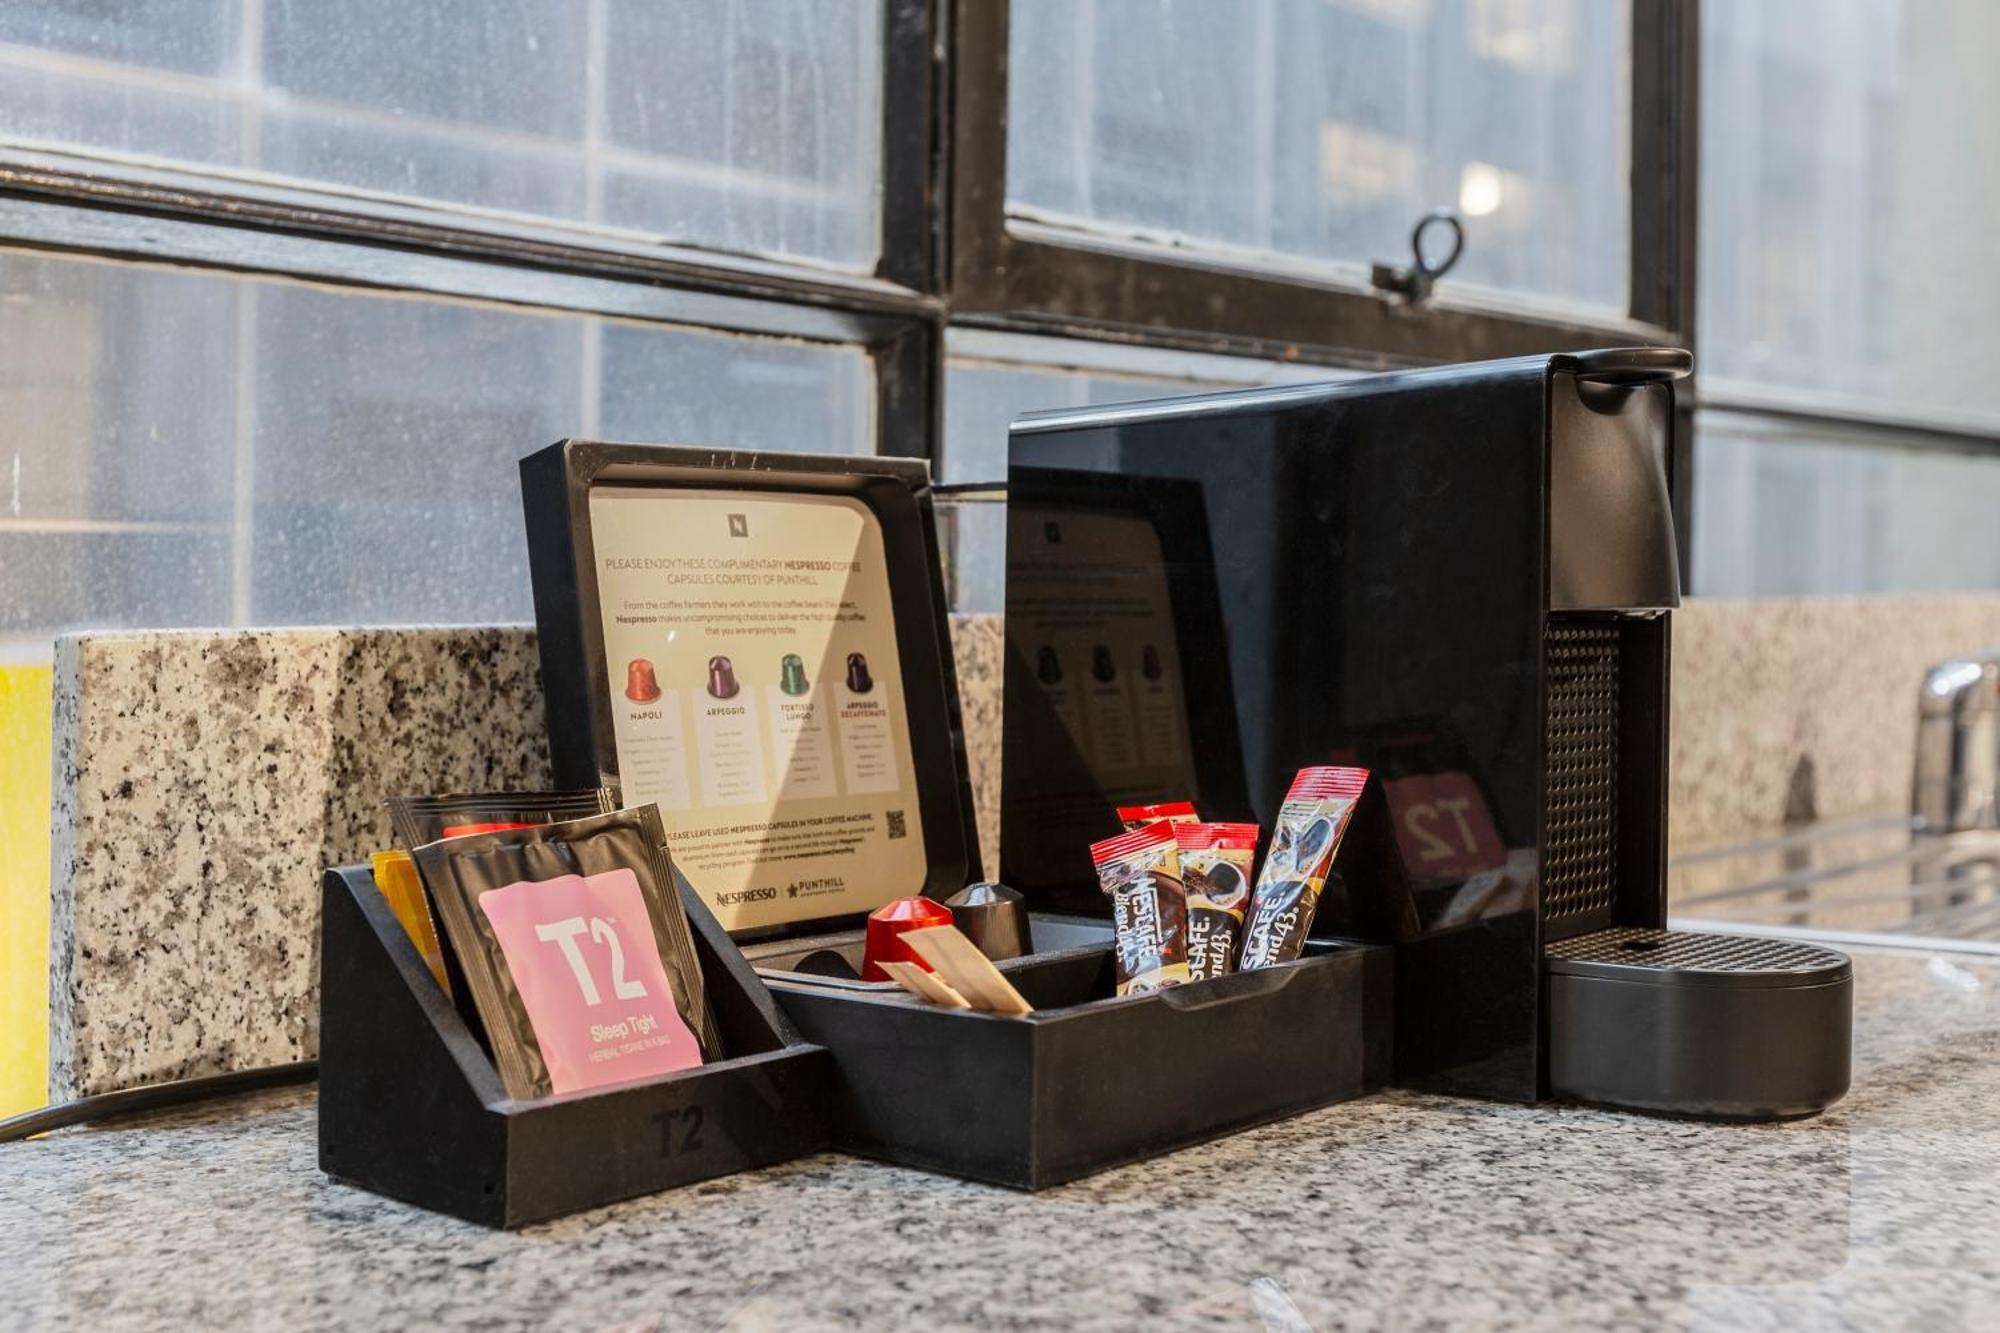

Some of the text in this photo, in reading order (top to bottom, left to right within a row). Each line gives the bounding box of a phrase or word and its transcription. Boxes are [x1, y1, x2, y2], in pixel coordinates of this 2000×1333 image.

[606, 558, 642, 570] PLEASE
[644, 558, 676, 570] ENJOY
[677, 558, 705, 570] THESE
[707, 558, 782, 570] COMPLIMENTARY
[784, 559, 831, 571] NESPRESSO
[667, 573, 818, 586] CAPSULES COURTESY OF PUNTHILL
[624, 600, 644, 610] From
[630, 710, 662, 720] NAPOLI
[706, 706, 745, 716] ARPEGGIO
[691, 827, 713, 839] LEAVE
[713, 825, 730, 836] USED
[730, 822, 767, 834] NESPRESSO
[799, 876, 844, 891] PUNTHILL
[716, 887, 777, 907] NESPRESSO
[534, 915, 648, 1007] T2
[590, 1014, 659, 1042] Sleep Tight
[652, 1104, 705, 1158] T2
